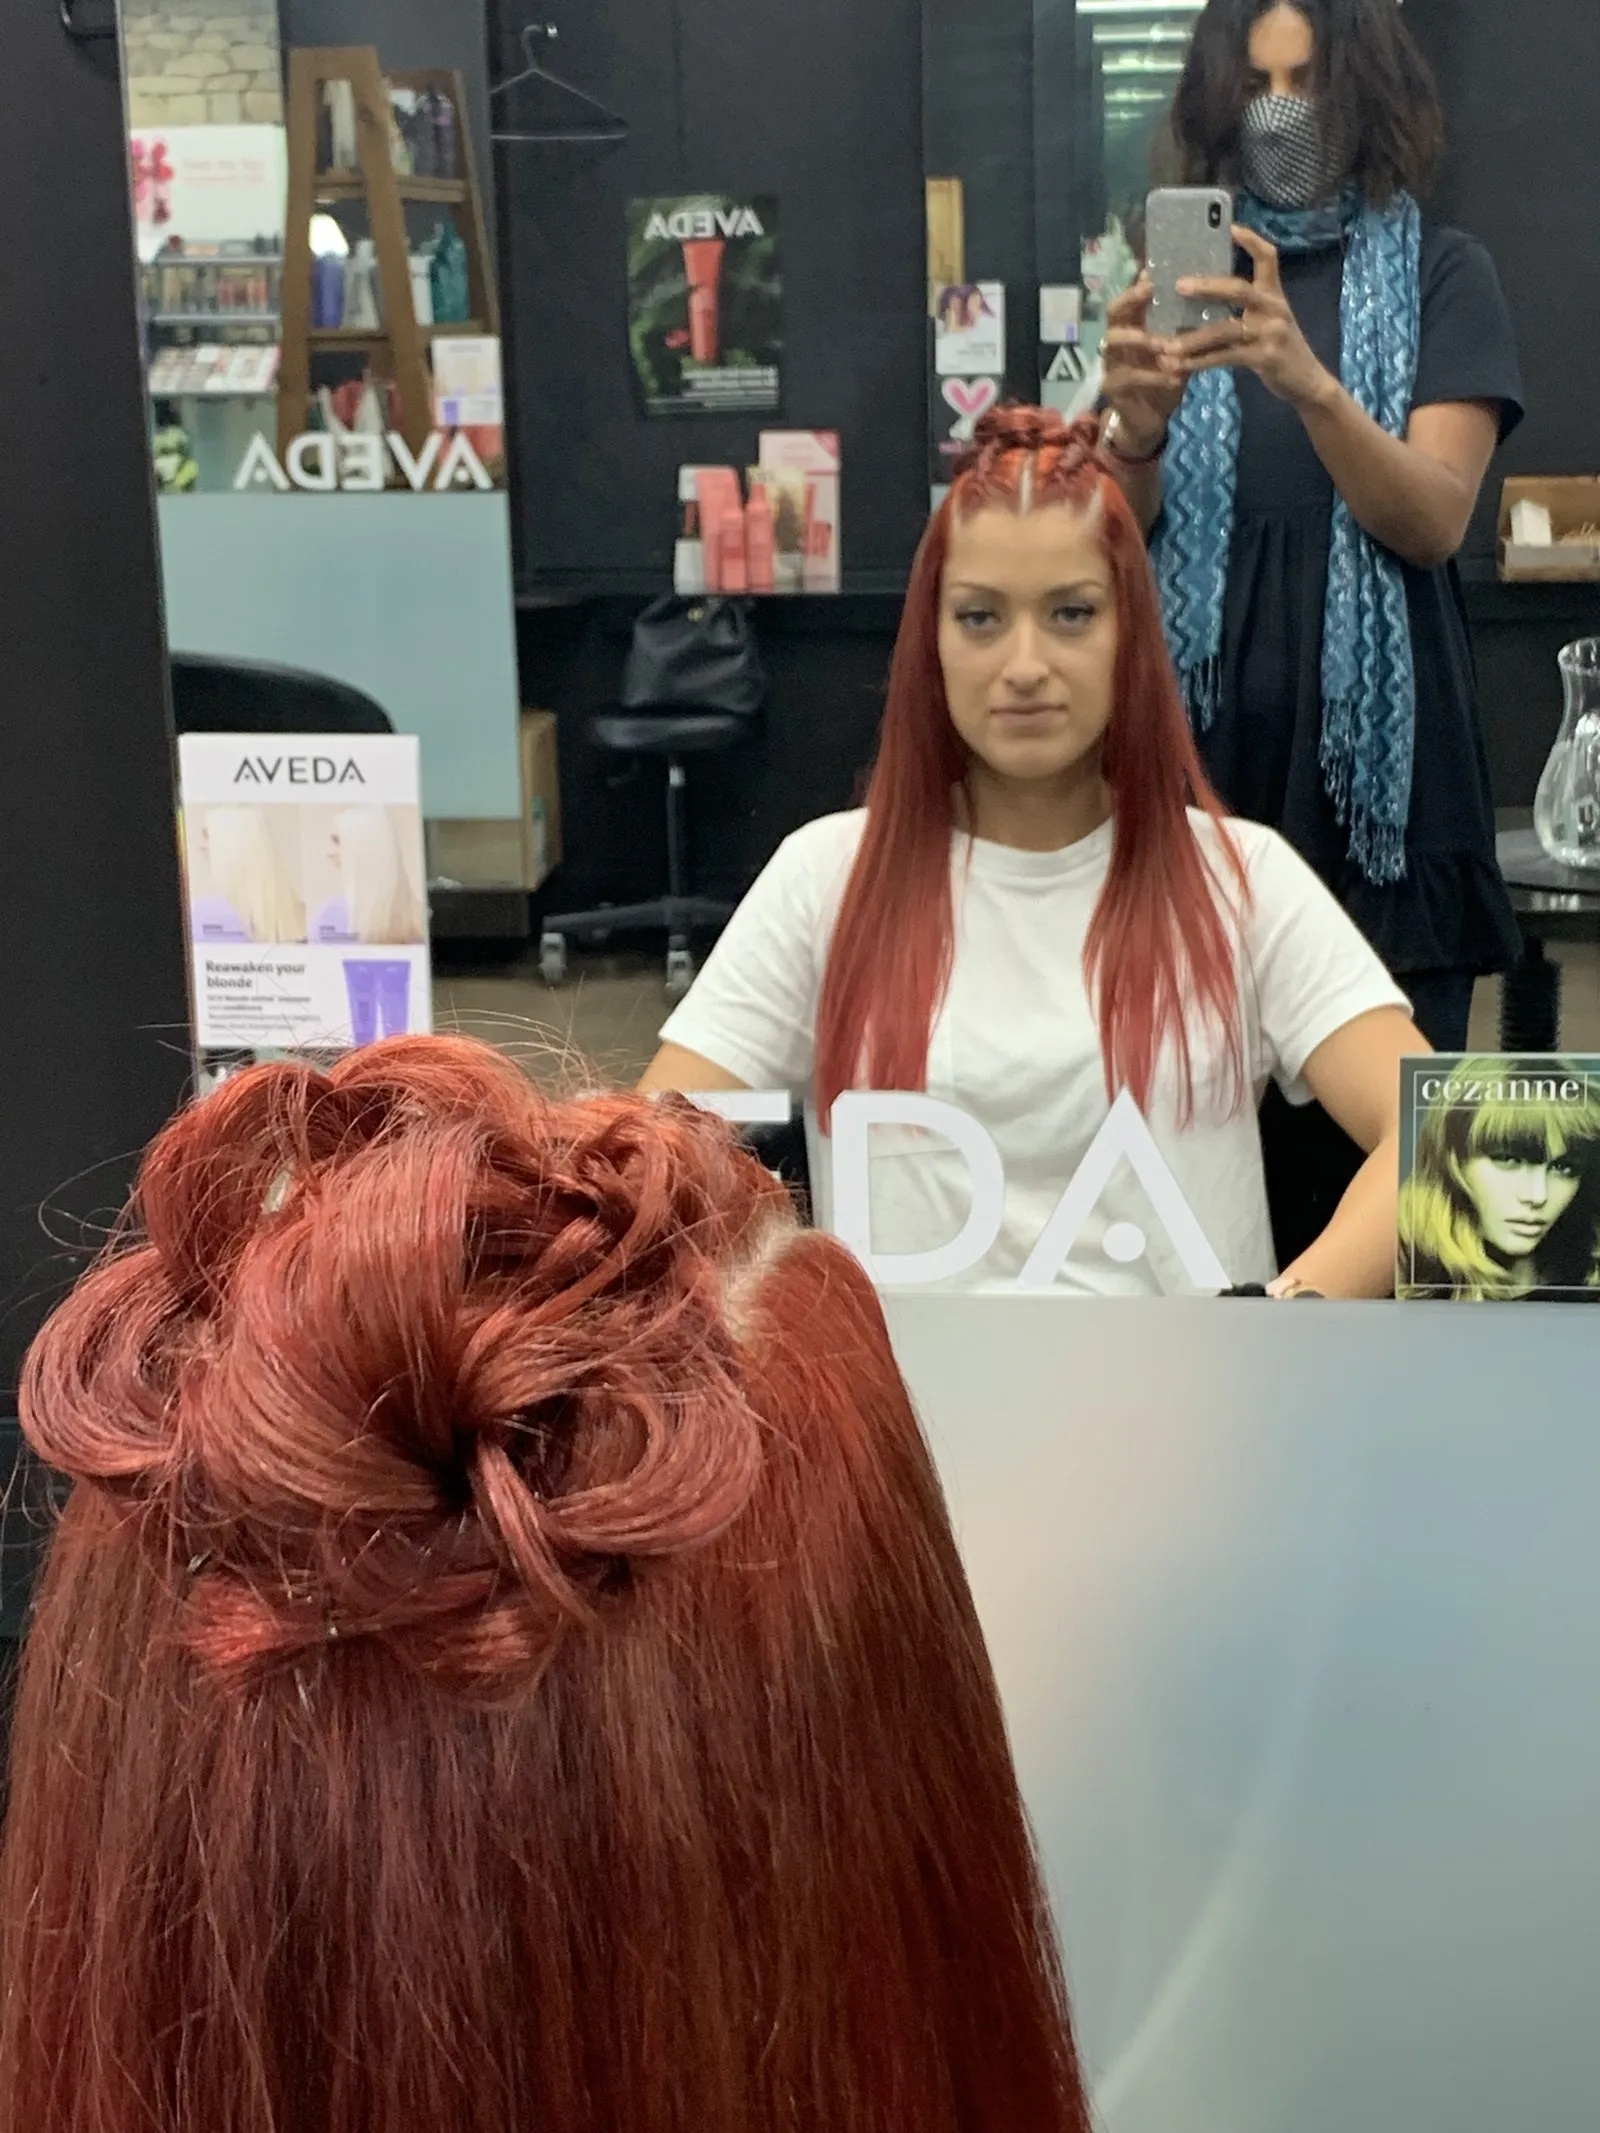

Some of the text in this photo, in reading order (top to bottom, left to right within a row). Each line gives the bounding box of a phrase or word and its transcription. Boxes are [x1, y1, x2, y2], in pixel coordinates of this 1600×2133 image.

[233, 755, 366, 784] AVEDA
[206, 960, 305, 977] Reawaken your
[207, 975, 253, 988] blonde
[1421, 1077, 1580, 1102] cezanne
